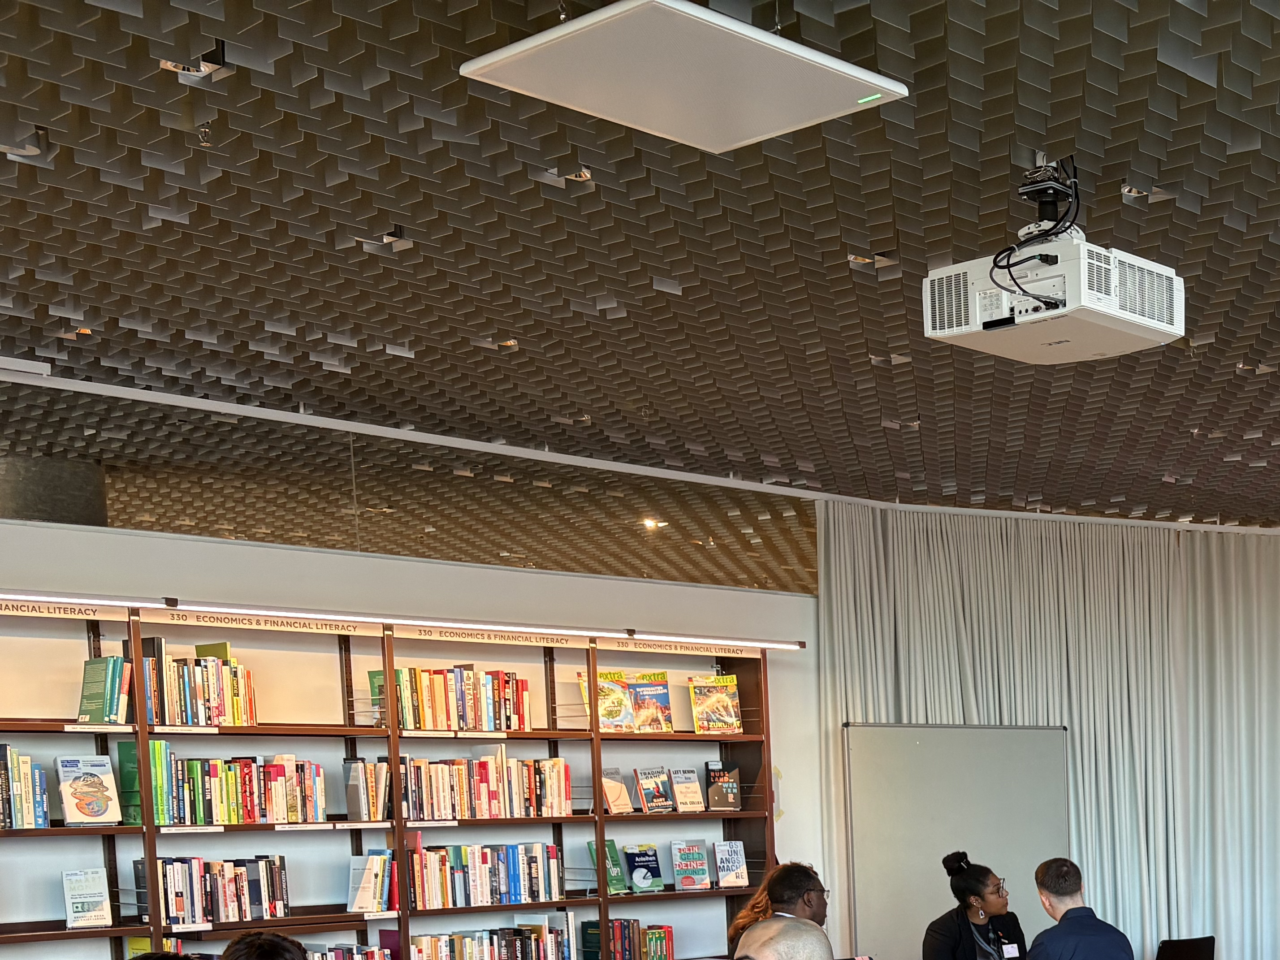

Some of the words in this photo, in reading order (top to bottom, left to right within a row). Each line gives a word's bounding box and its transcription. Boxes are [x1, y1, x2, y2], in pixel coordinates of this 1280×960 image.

[47, 606, 98, 617] LITERACY
[169, 613, 188, 622] 330
[196, 615, 253, 626] ECONOMICS
[255, 618, 262, 626] &
[264, 619, 314, 630] FINANCIAL
[316, 622, 358, 632] LITERACY
[418, 629, 433, 637] 330
[439, 630, 486, 640] ECONOMICS
[494, 634, 534, 643] FINANCIAL
[535, 637, 569, 645] LITERACY
[634, 642, 673, 651] ECONOMICS
[680, 645, 714, 653] FINANCIAL
[714, 647, 744, 655] LITERACY
[599, 671, 623, 680] extra
[642, 672, 666, 681] extra
[708, 721, 741, 729] ZUKUT
